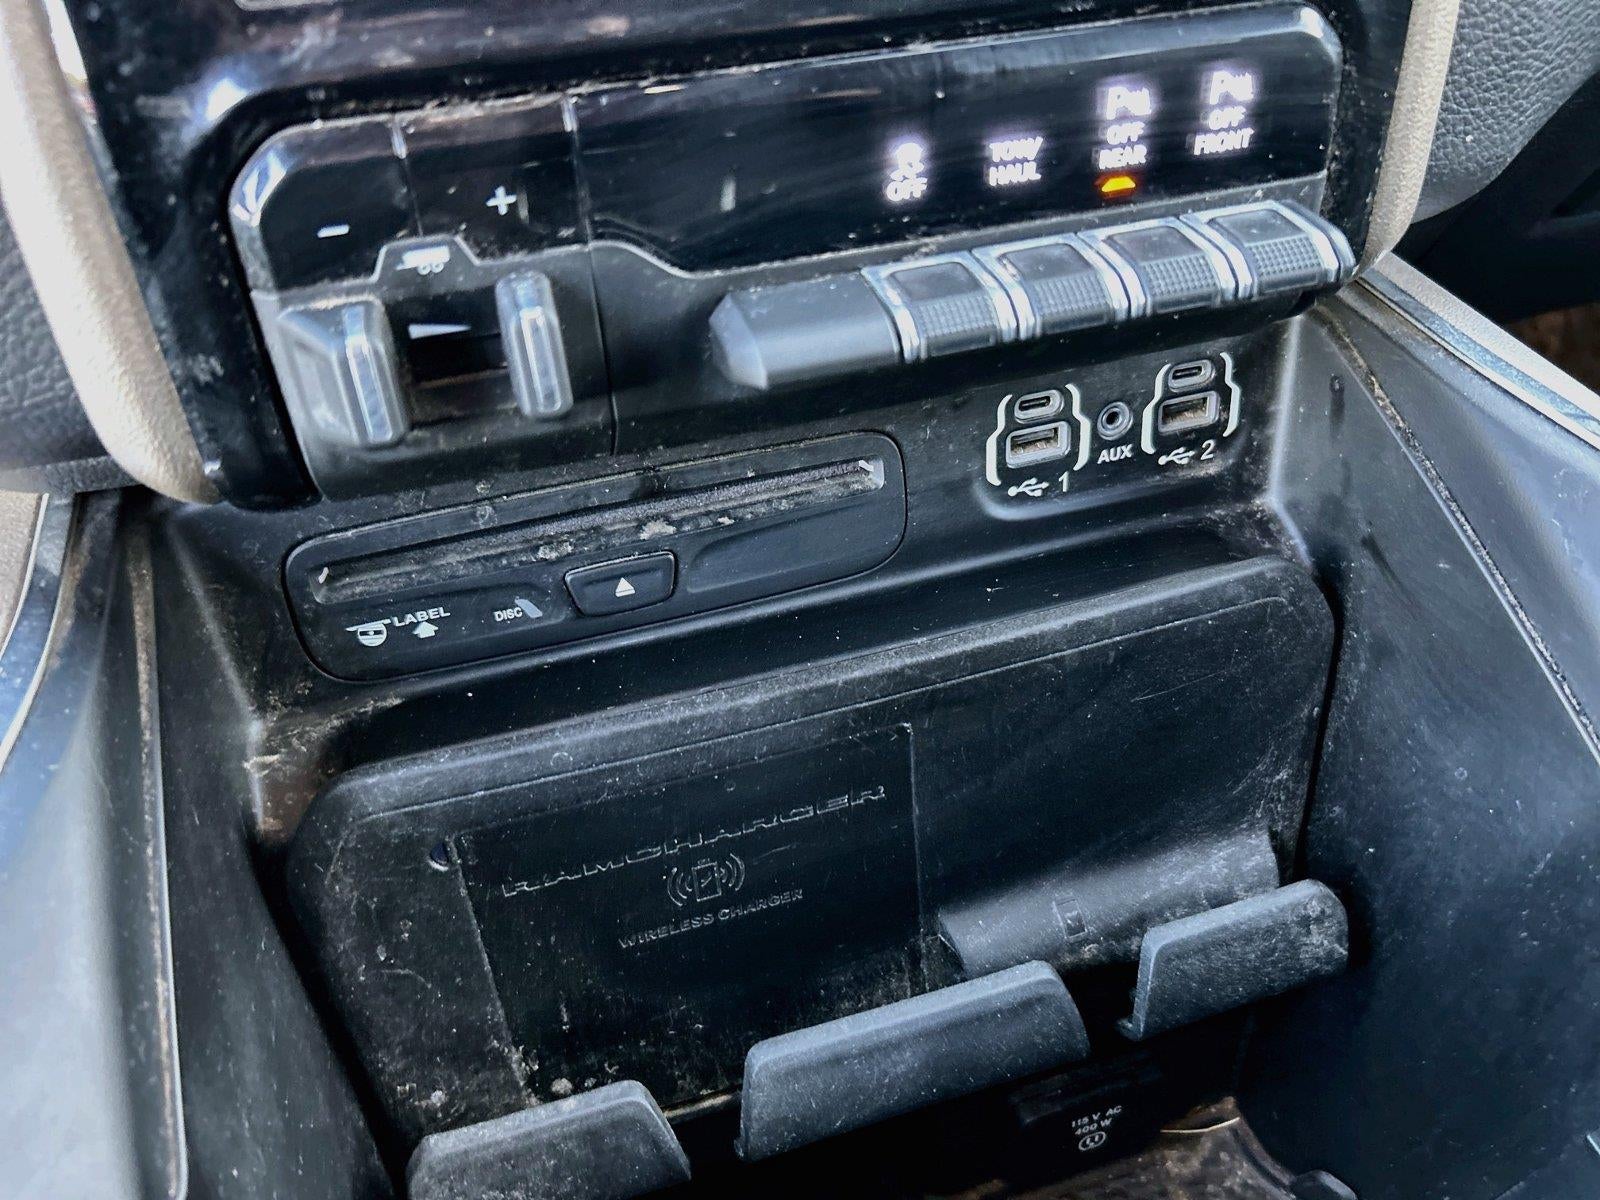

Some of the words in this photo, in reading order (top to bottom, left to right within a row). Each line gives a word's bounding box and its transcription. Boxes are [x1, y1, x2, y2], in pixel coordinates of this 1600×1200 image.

[1208, 106, 1246, 130] OFF
[1106, 121, 1145, 145] OFF
[1193, 127, 1254, 156] FRONT
[989, 136, 1044, 163] TOW/
[1099, 144, 1148, 170] REAR
[989, 161, 1042, 187] HAUL
[886, 177, 928, 202] OFF
[1097, 443, 1133, 465] AUX
[1199, 439, 1217, 461] 2
[1058, 471, 1070, 493] 1
[391, 606, 451, 627] LABEL
[493, 606, 523, 623] DISC
[501, 784, 886, 898] RAMCHARGER
[617, 911, 716, 949] WIRELESS
[717, 887, 804, 921] CHARGER
[1091, 1112, 1101, 1121] V
[1105, 1105, 1122, 1117] AC
[1100, 1117, 1113, 1128] W
